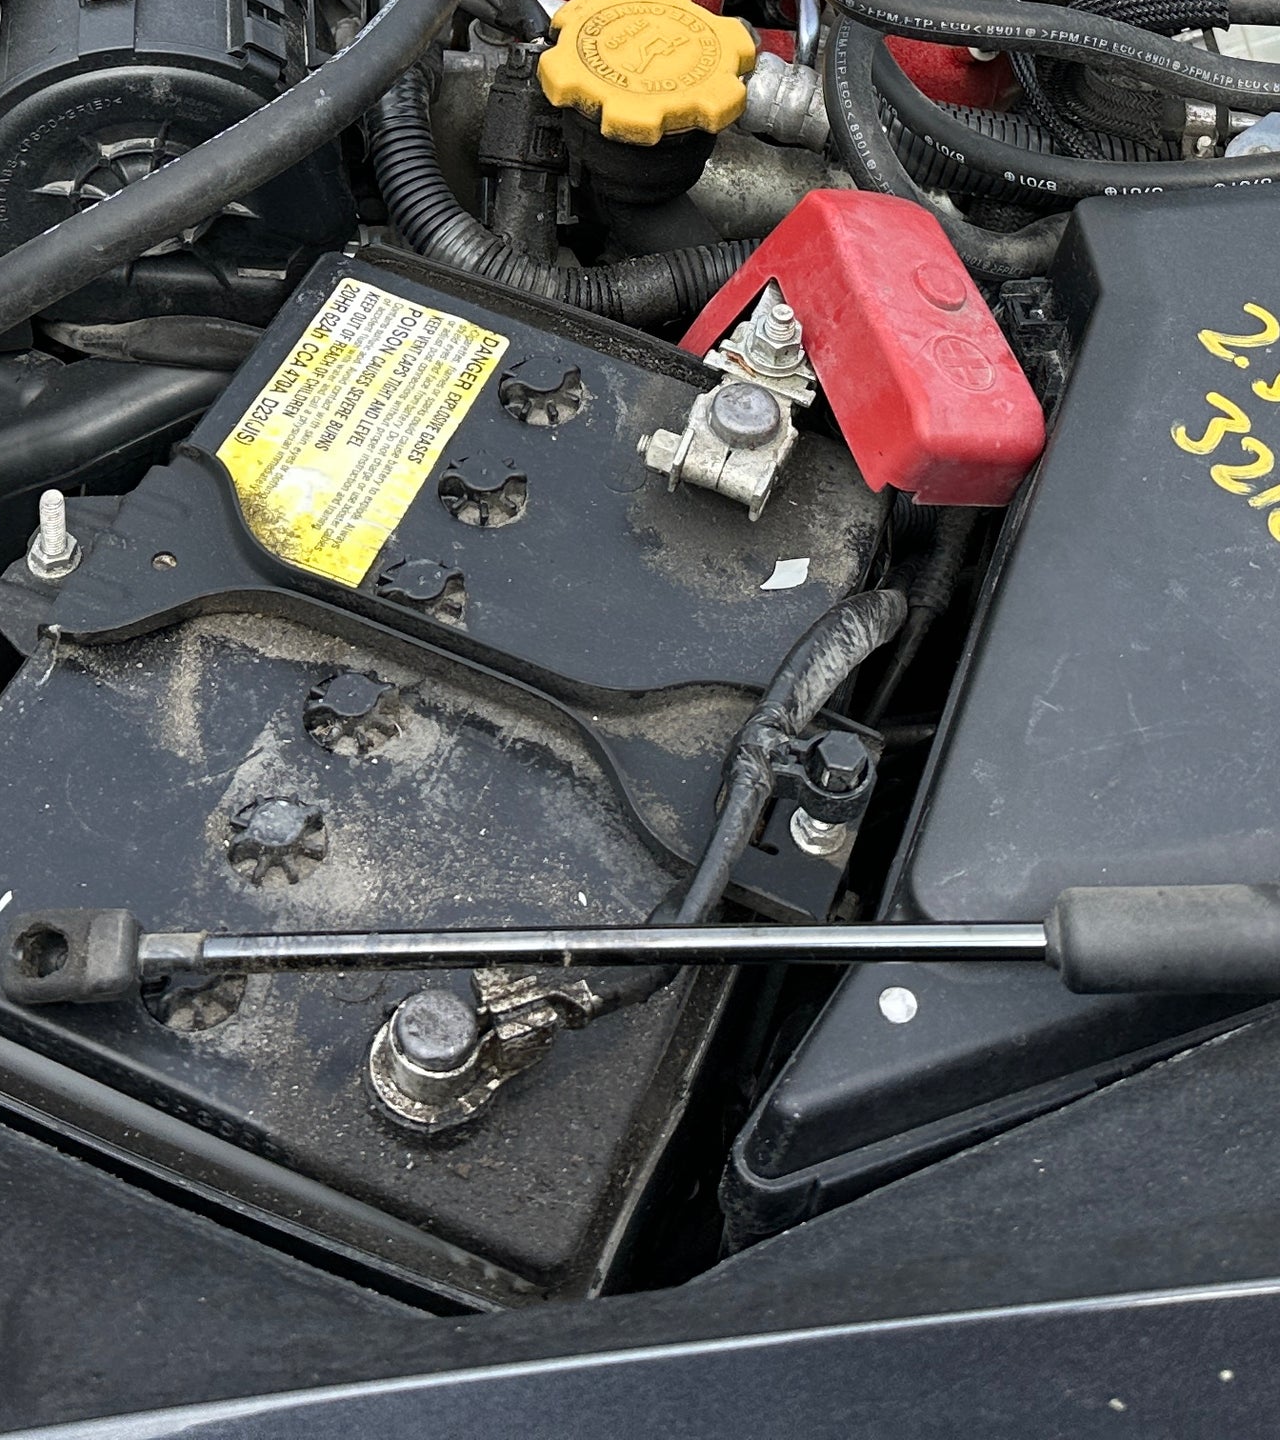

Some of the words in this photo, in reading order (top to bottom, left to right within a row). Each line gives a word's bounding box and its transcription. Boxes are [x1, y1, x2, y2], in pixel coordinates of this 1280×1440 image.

[605, 19, 650, 50] 5W-30
[668, 11, 704, 33] SEE
[582, 38, 629, 88] MANUAL
[679, 38, 717, 87] ENGINE
[641, 79, 678, 92] OIL
[1019, 174, 1058, 192] 8701
[328, 282, 362, 314] 20HR
[356, 290, 381, 313] KEEP
[308, 310, 342, 341] 62Ah
[337, 327, 356, 342] OF
[345, 311, 367, 330] OUT
[378, 306, 424, 356] POISON
[420, 313, 444, 335] KEEP
[288, 341, 321, 370] CCA
[318, 339, 348, 368] REACH
[406, 333, 431, 355] VENT
[309, 365, 329, 379] OF
[354, 354, 387, 387] CAUSES
[391, 352, 418, 378] CAPS
[453, 336, 500, 391] DANGER
[268, 366, 302, 397] 470A
[375, 375, 403, 401] TIGHT
[280, 375, 321, 419] CHILDREN
[332, 385, 366, 421] SEVERE
[362, 397, 387, 420] AND
[425, 390, 463, 433] EXPLOSIVE
[232, 395, 280, 447] D23(JIS)
[312, 419, 345, 452] BURNS
[344, 418, 375, 448] LEVEL
[405, 431, 437, 464] GASES
[371, 458, 398, 487] battery
[366, 486, 380, 496] to
